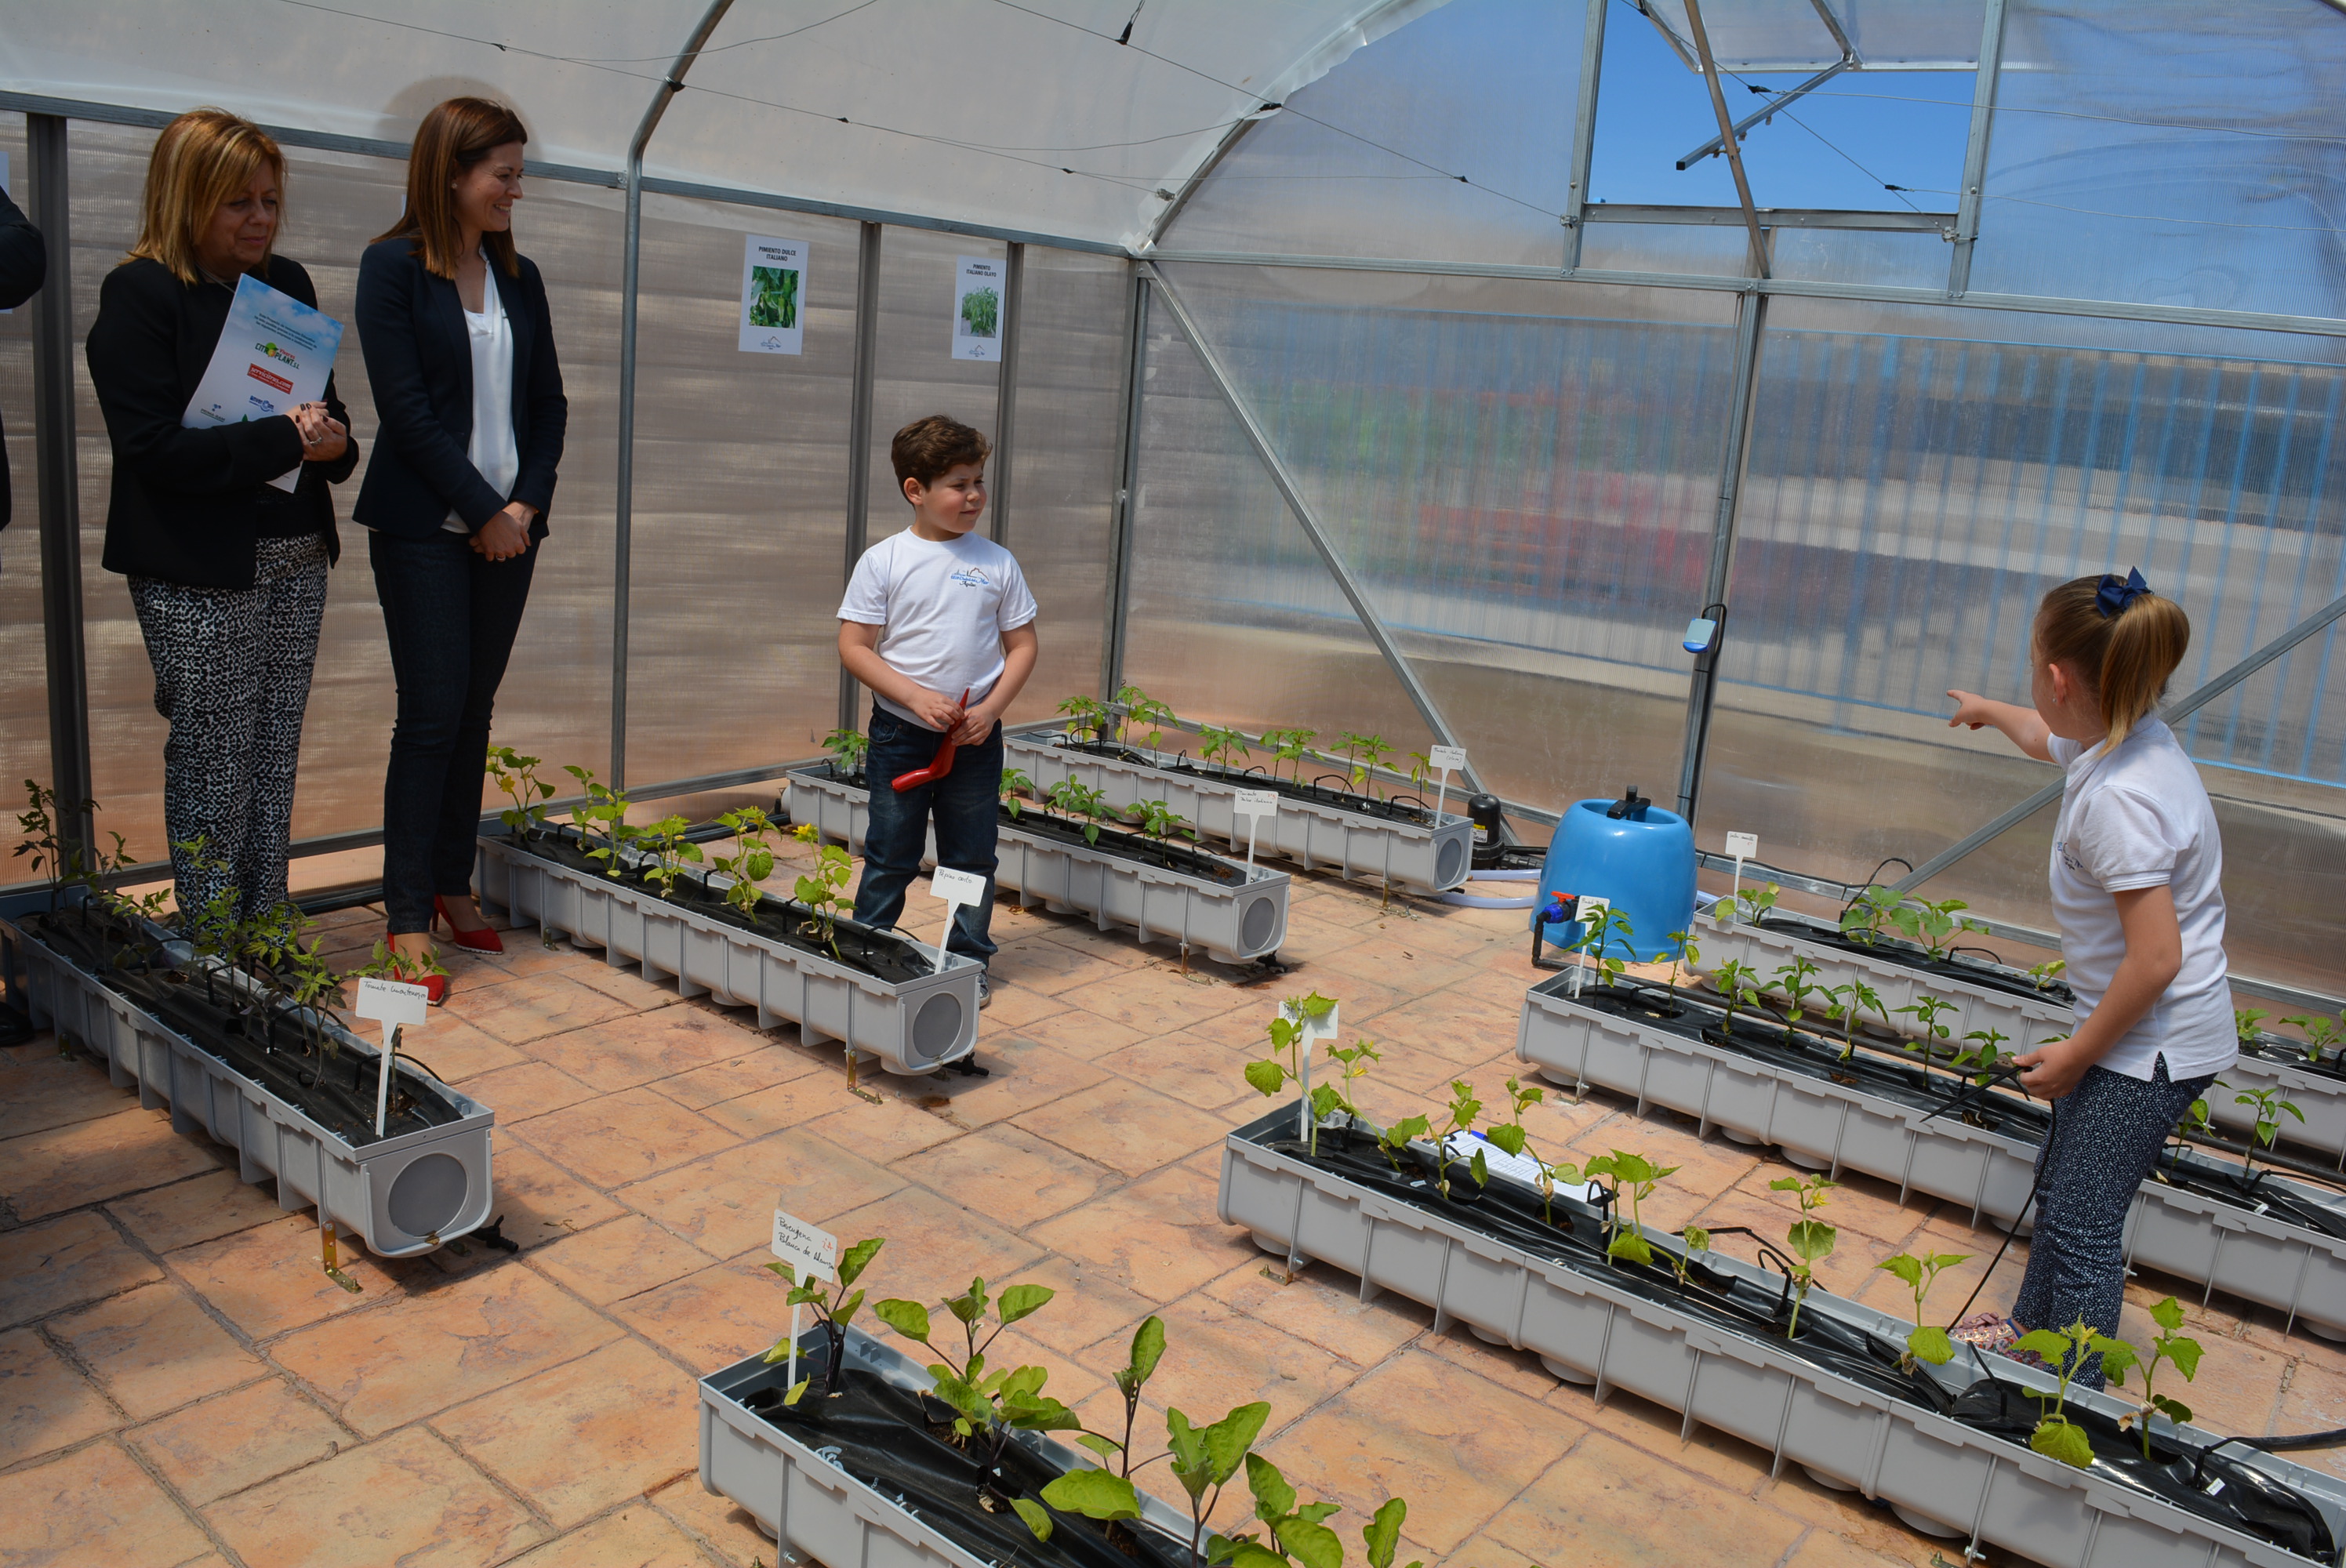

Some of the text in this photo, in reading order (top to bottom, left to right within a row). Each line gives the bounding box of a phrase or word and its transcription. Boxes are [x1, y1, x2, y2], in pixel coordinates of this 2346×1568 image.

[759, 246, 781, 254] PIMIENTO
[938, 869, 955, 880] Pepino
[363, 981, 386, 992] Tomate
[779, 1232, 801, 1251] Blanca
[803, 1246, 810, 1257] de
